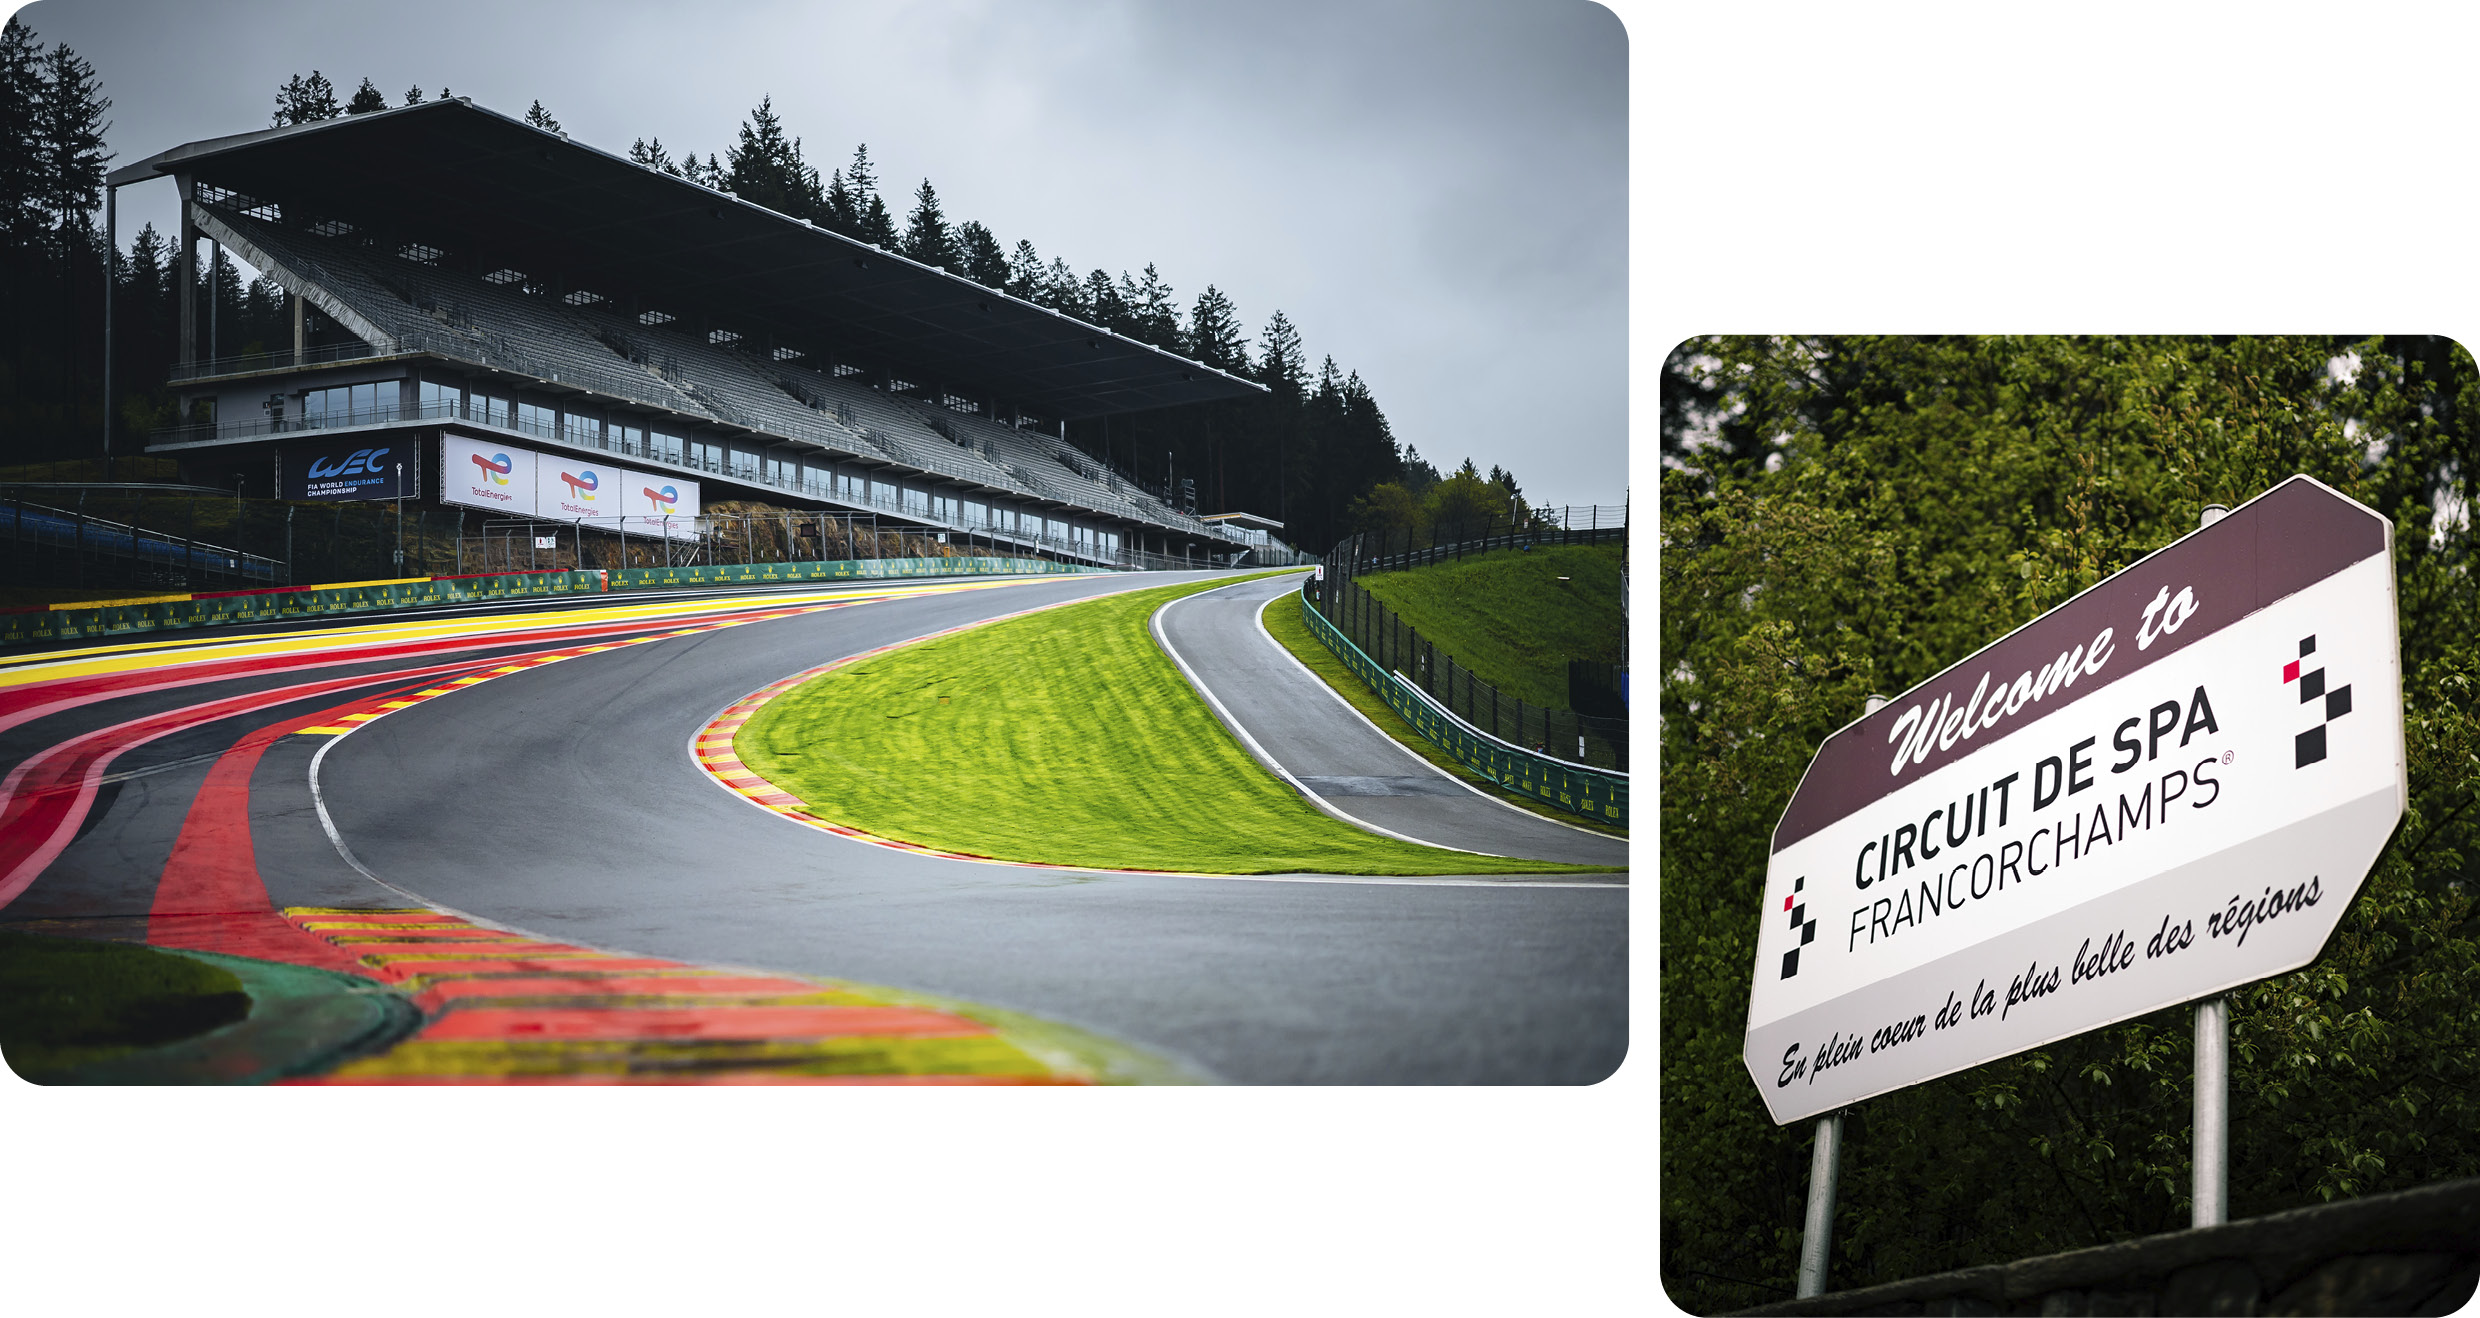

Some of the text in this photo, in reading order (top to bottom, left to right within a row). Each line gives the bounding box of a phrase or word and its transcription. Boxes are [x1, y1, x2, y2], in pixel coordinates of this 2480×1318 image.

[308, 448, 390, 478] WEC
[319, 481, 344, 489] WORLD
[344, 477, 384, 487] ENDURANCE
[307, 487, 357, 497] CHAMPIONSHIP
[471, 486, 513, 501] TotalEnergies
[561, 502, 599, 518] TotalEnergies
[138, 620, 156, 628] ROLEX
[1889, 585, 2200, 776] Welcome to
[1855, 685, 2218, 890] CIRCUIT DE SPA
[1777, 875, 2323, 1088] En plein coeur de la plus belle des régions
